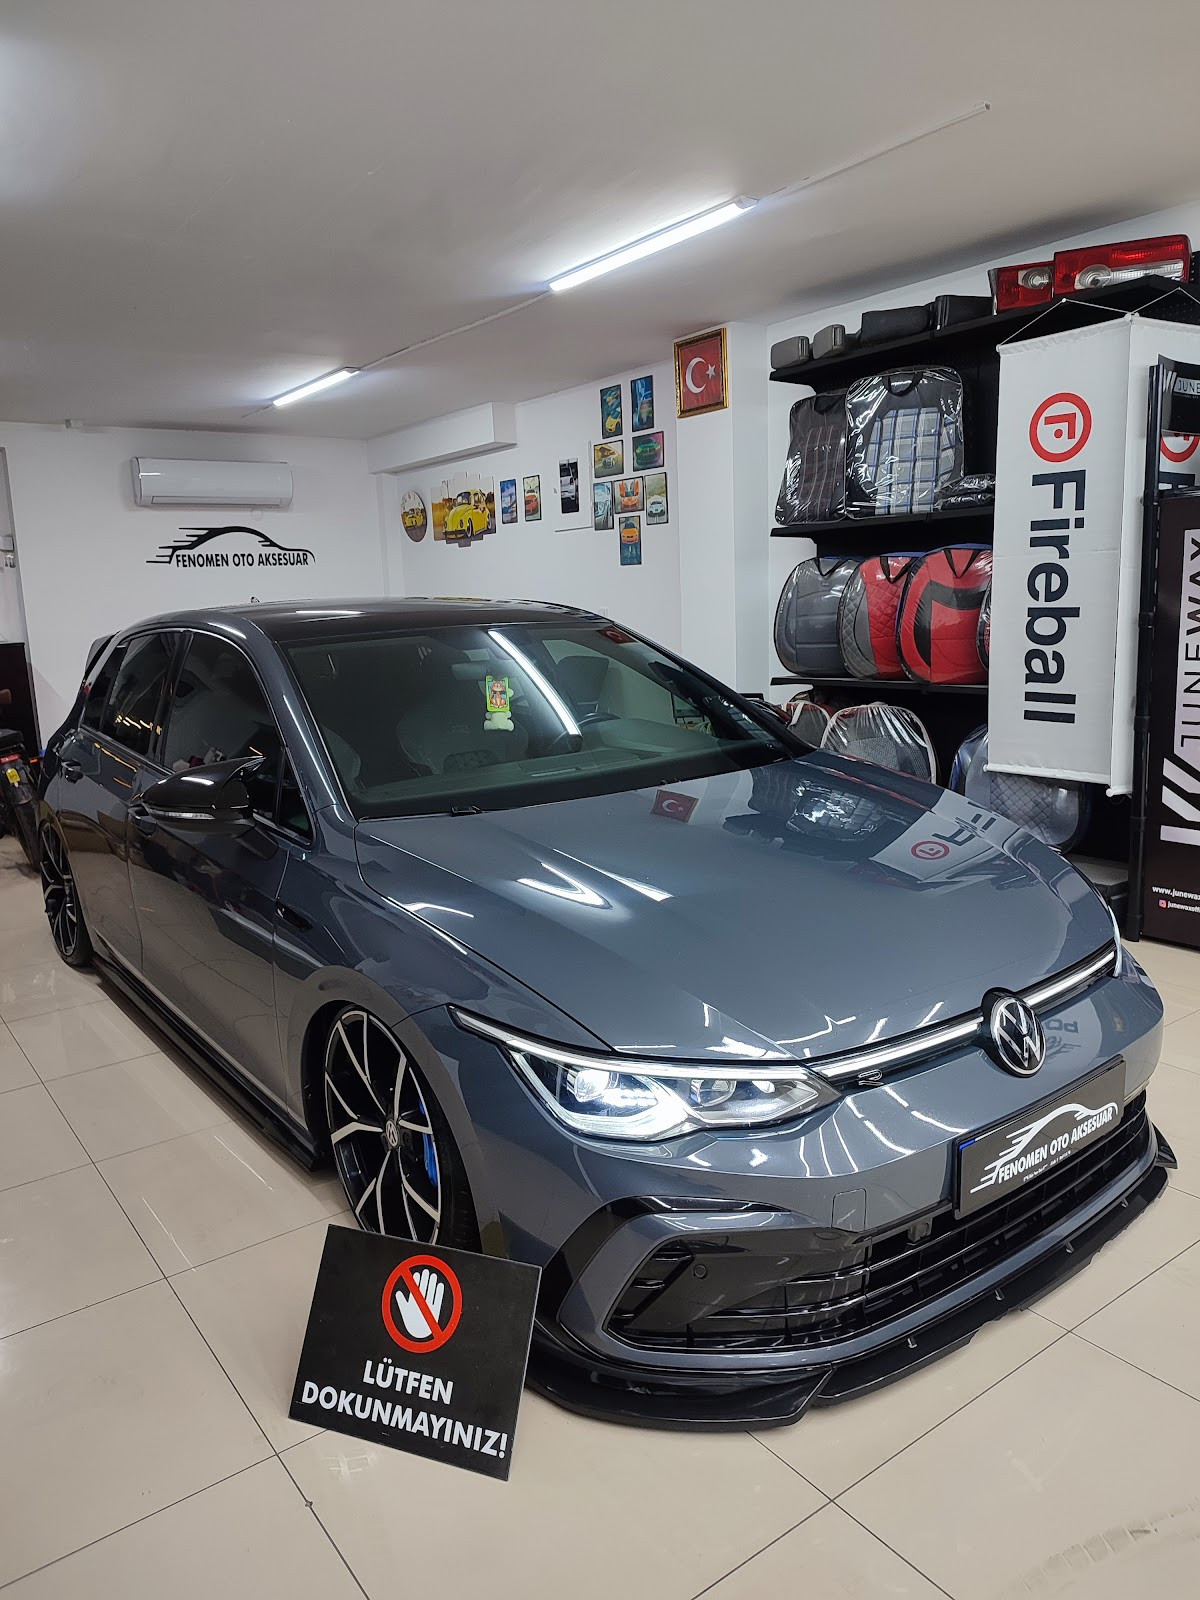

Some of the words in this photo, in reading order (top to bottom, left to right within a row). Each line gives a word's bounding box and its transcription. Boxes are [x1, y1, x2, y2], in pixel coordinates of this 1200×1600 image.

[176, 553, 229, 568] FENOMEN
[232, 553, 255, 567] OTO
[258, 552, 309, 567] AKSESUAR
[1024, 469, 1086, 724] Fireball
[998, 1144, 1048, 1184] FENOMEN
[1049, 1132, 1070, 1156] OTO
[1071, 1107, 1113, 1145] AKSESUAR
[362, 1357, 454, 1405] LÜTFEN
[301, 1381, 508, 1459] DOKUNMAYINIZ!
